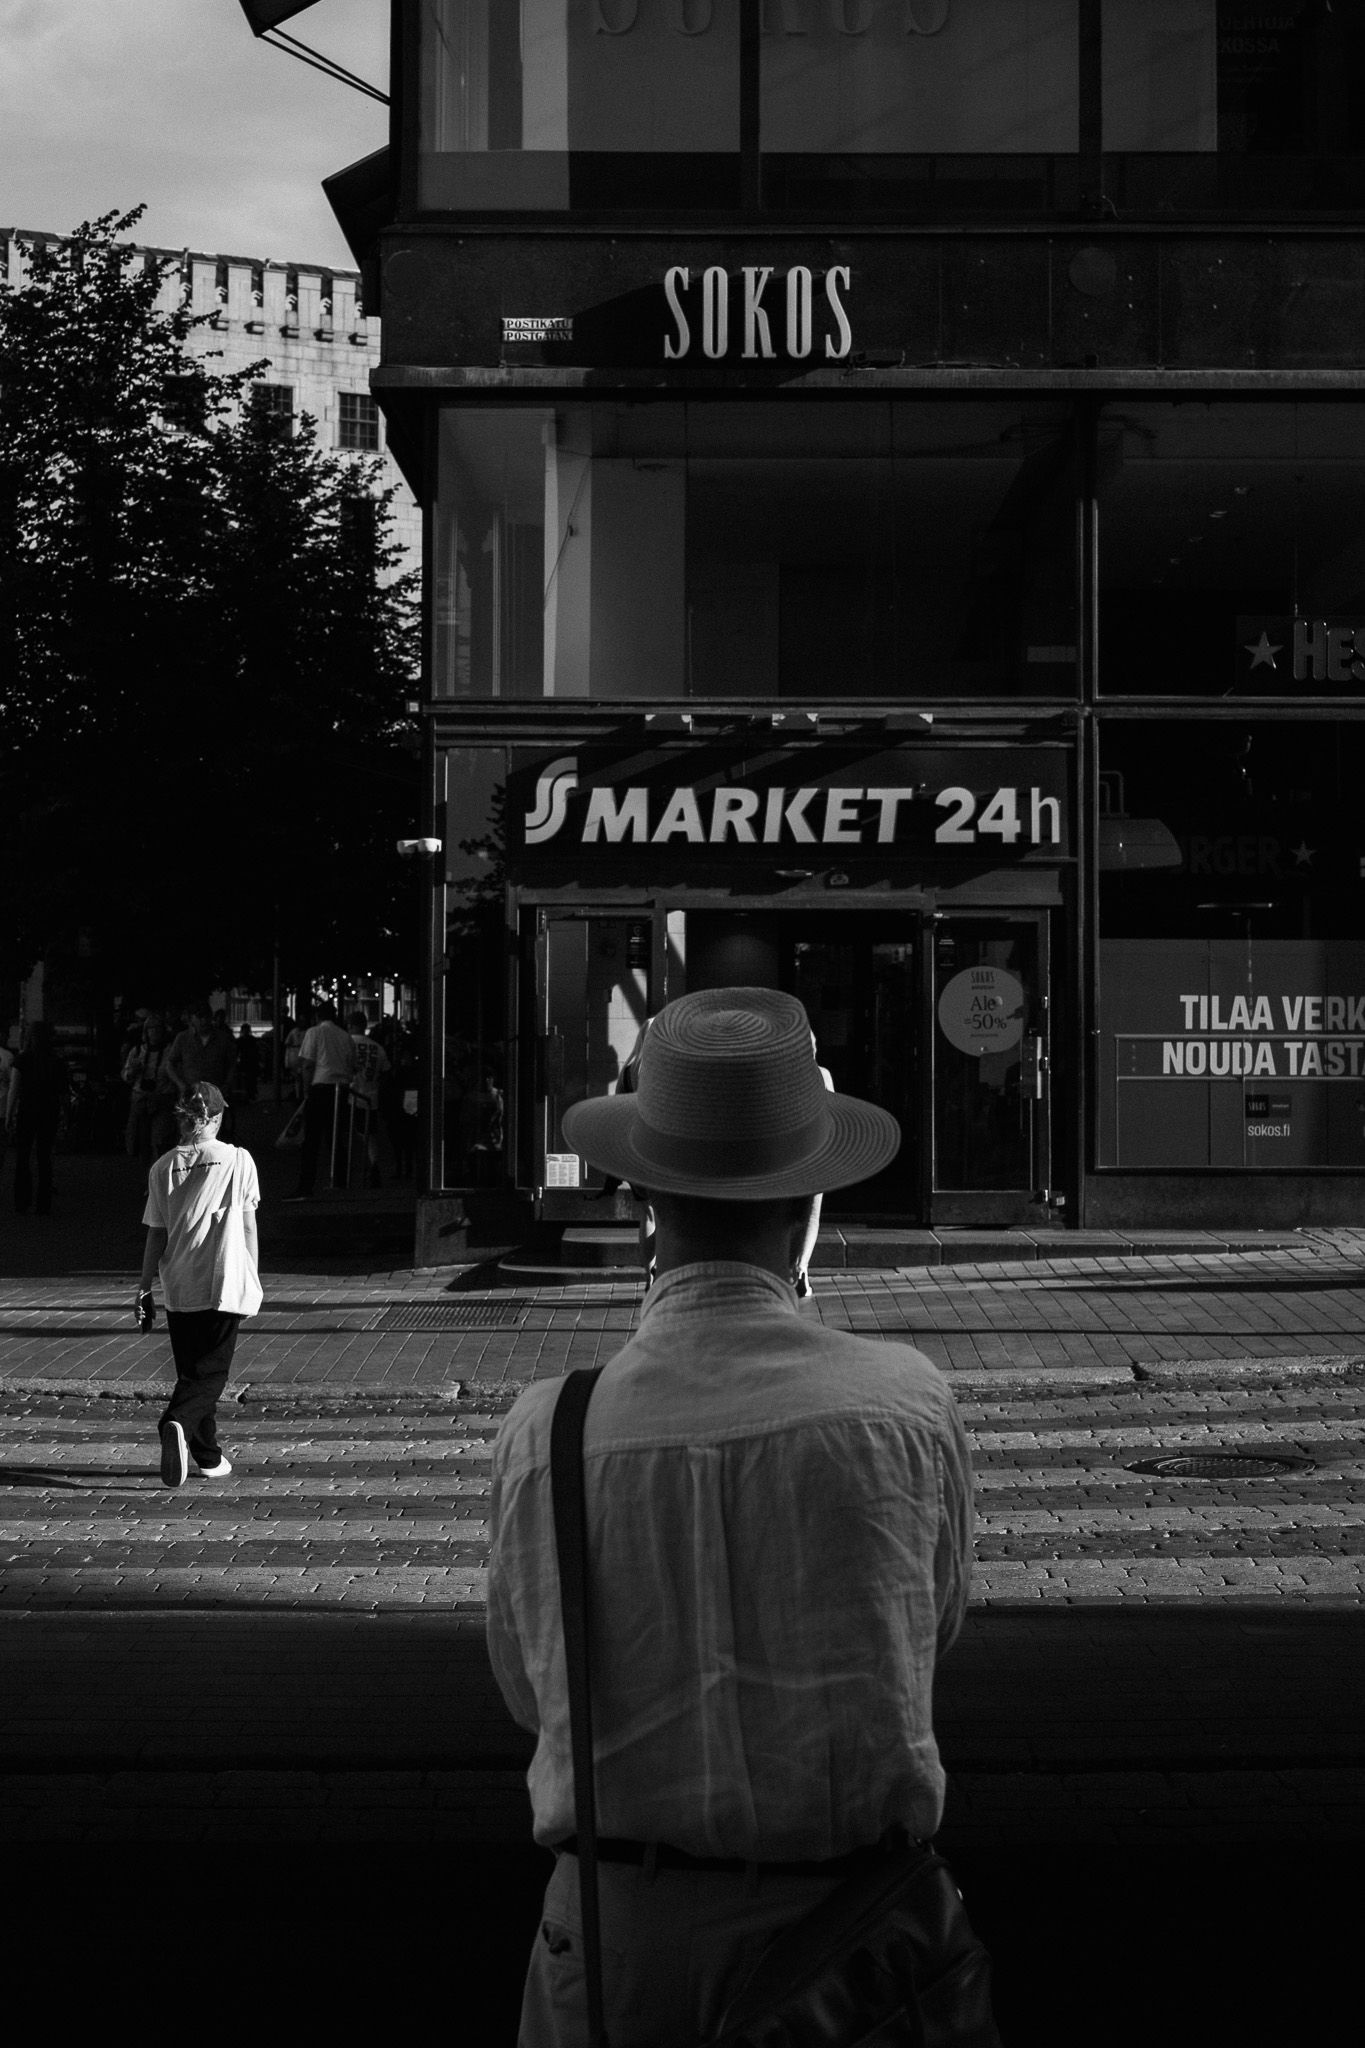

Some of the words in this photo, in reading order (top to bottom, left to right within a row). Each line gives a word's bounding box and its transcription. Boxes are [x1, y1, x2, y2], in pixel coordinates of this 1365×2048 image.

[506, 319, 570, 329] POSTIKATU
[664, 266, 851, 359] SOKOS
[581, 787, 913, 843] MARKET
[934, 787, 1061, 843] 24h
[1173, 836, 1281, 875] RGER
[970, 995, 997, 1011] Ale
[1180, 995, 1274, 1030] TILAA
[1163, 1041, 1276, 1076] NOUDA
[1284, 1041, 1365, 1076] TAST
[1247, 1123, 1290, 1137] sokos.fi
